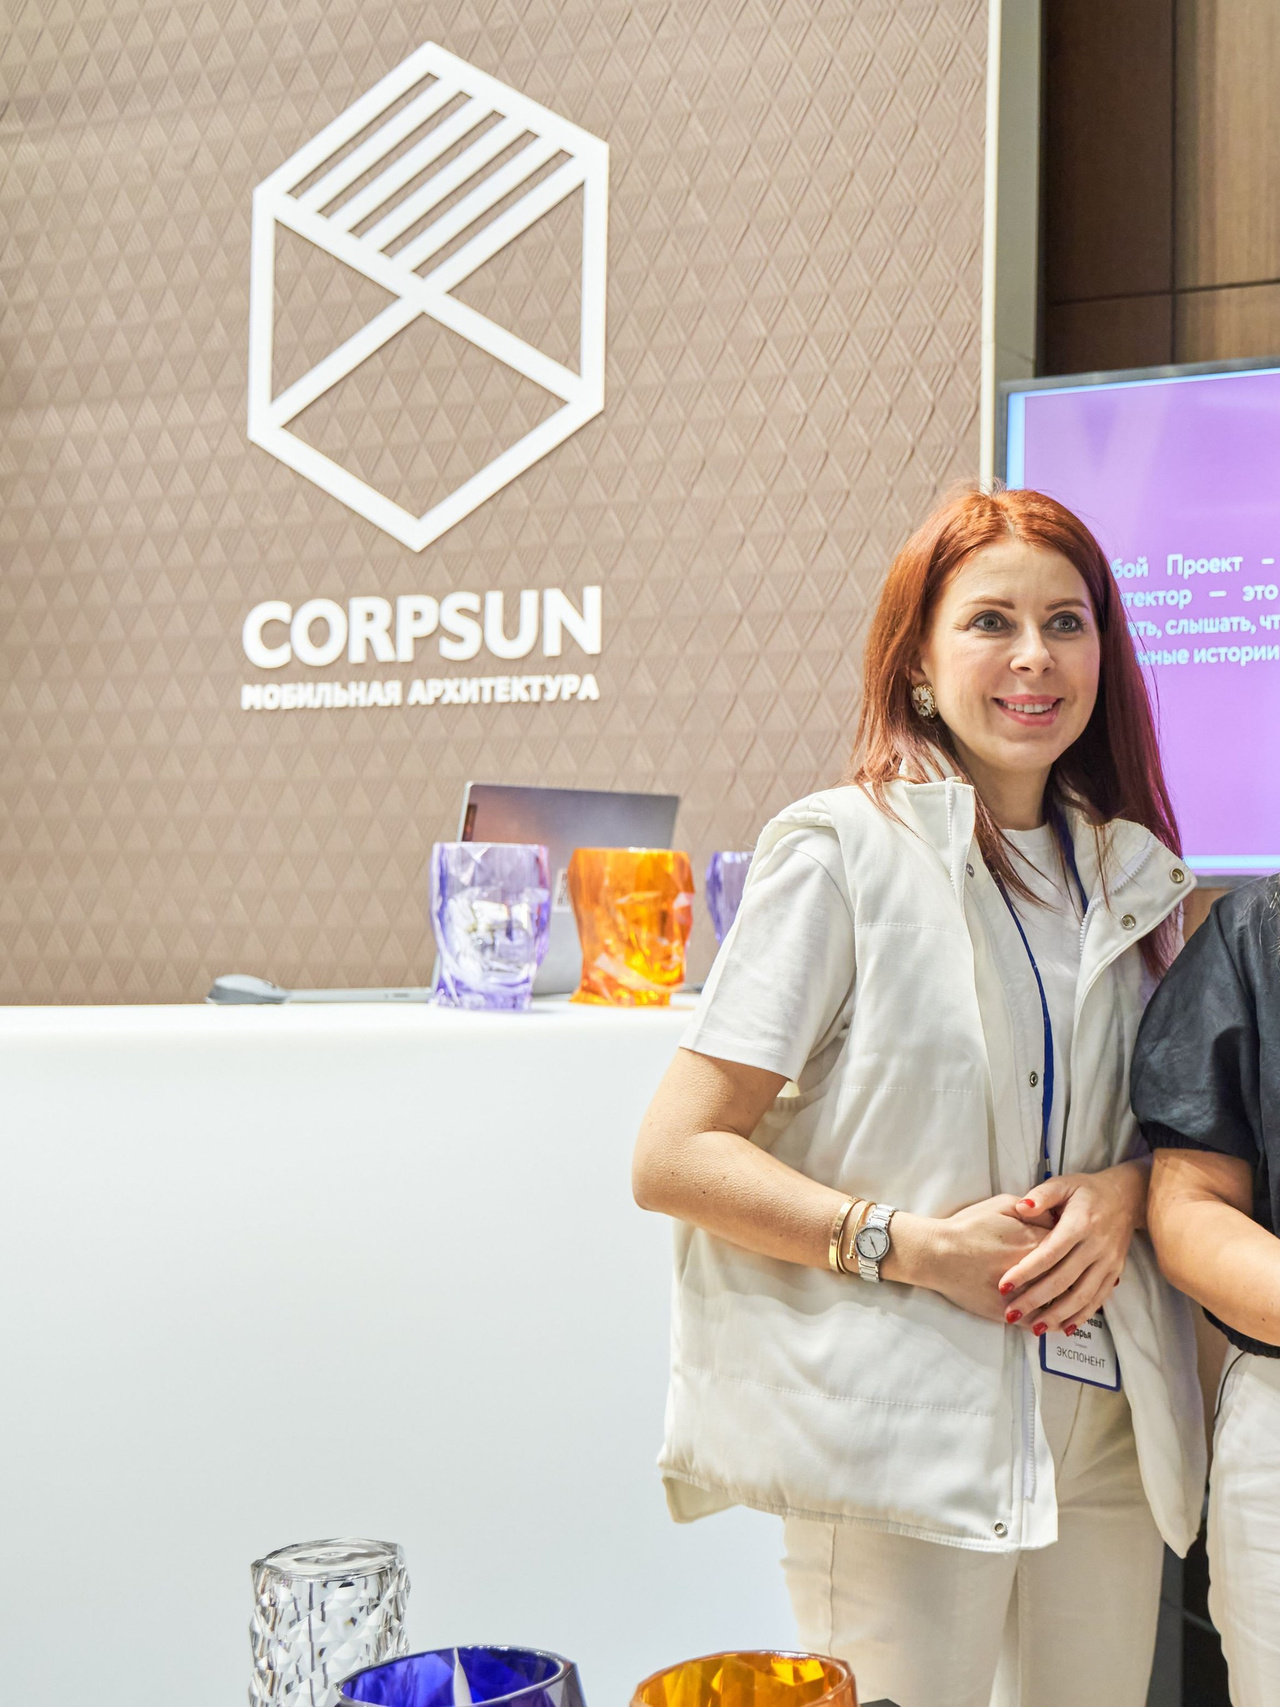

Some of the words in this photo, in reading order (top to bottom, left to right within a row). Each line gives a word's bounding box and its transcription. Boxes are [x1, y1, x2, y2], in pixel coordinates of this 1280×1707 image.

[1110, 556, 1149, 580] бой
[1166, 553, 1244, 580] Проект
[1121, 589, 1193, 610] тектор
[1242, 582, 1279, 602] это
[241, 584, 603, 670] CORPSUN
[1165, 613, 1257, 636] слышать,
[1193, 643, 1280, 667] истории
[240, 680, 402, 711] МОБИЛЬНАЯ
[407, 673, 601, 706] АРХИТЕКТУРА
[1056, 1345, 1106, 1369] ЭКСПОНЕНТ
